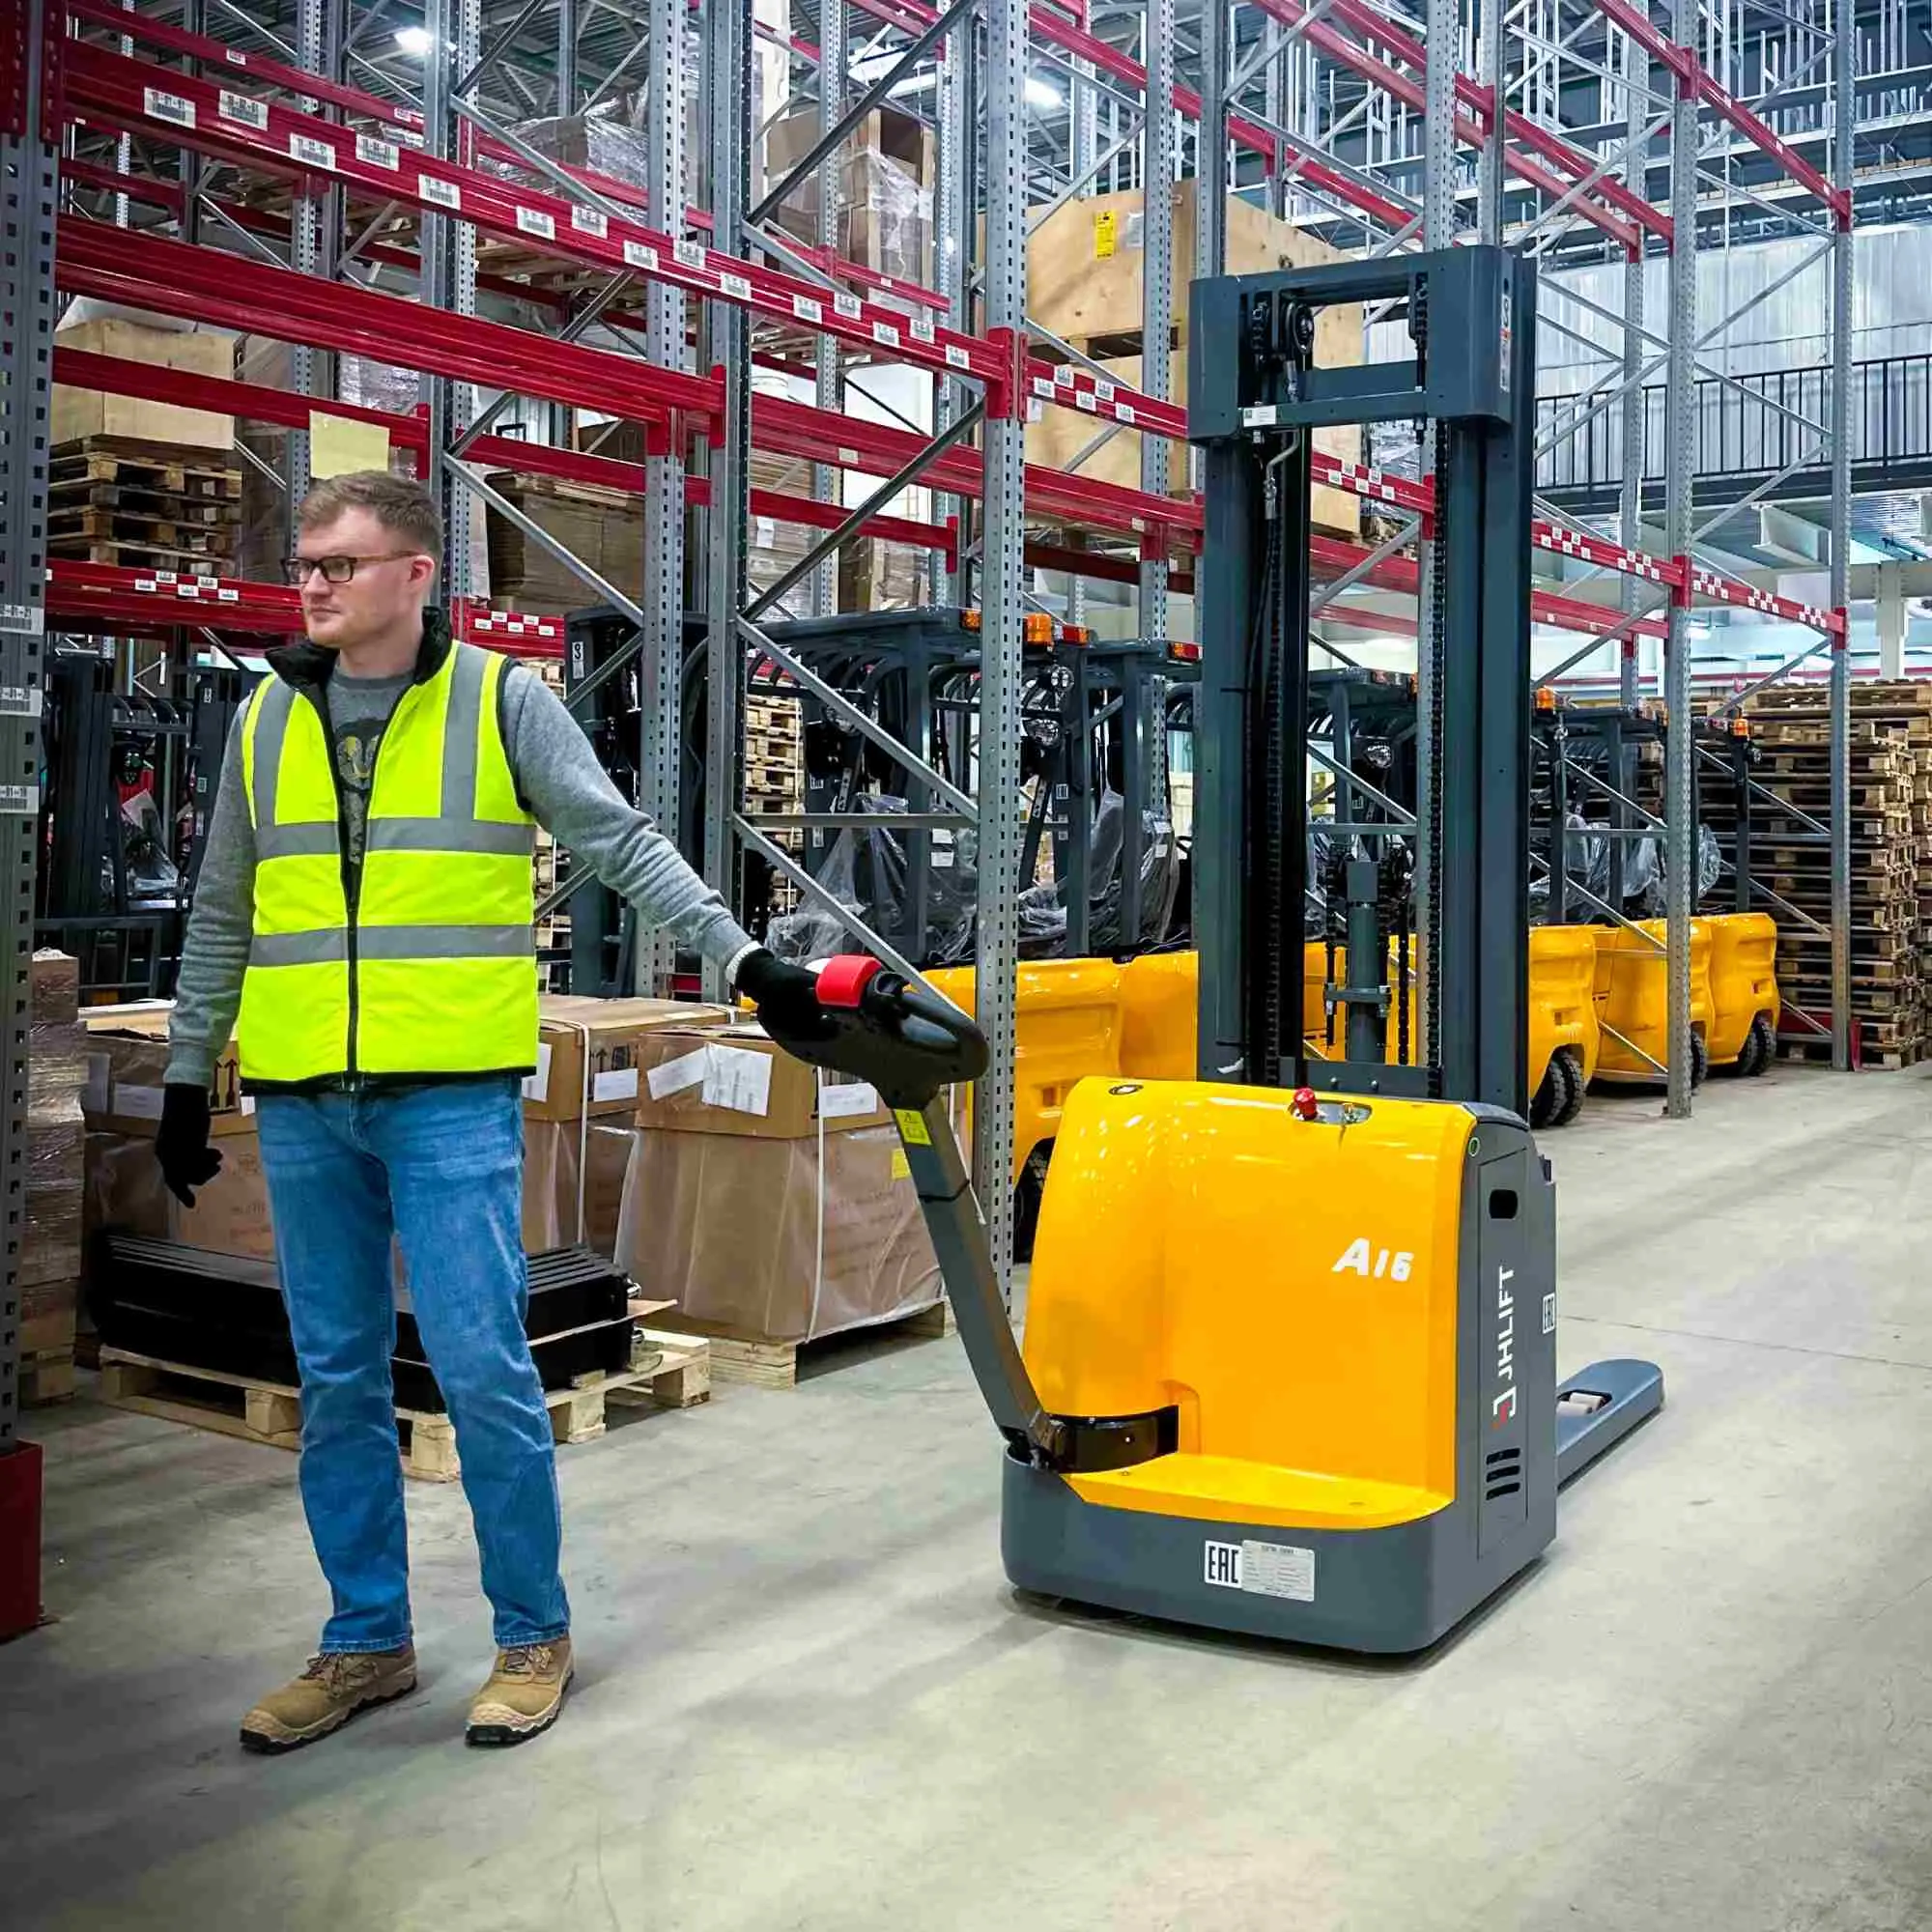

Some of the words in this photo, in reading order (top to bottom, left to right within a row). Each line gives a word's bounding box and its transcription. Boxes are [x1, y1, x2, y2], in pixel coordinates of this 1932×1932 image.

[1331, 1236, 1415, 1282] A16
[1498, 1265, 1515, 1380] JHLIFT
[1208, 1545, 1239, 1584] EAC
